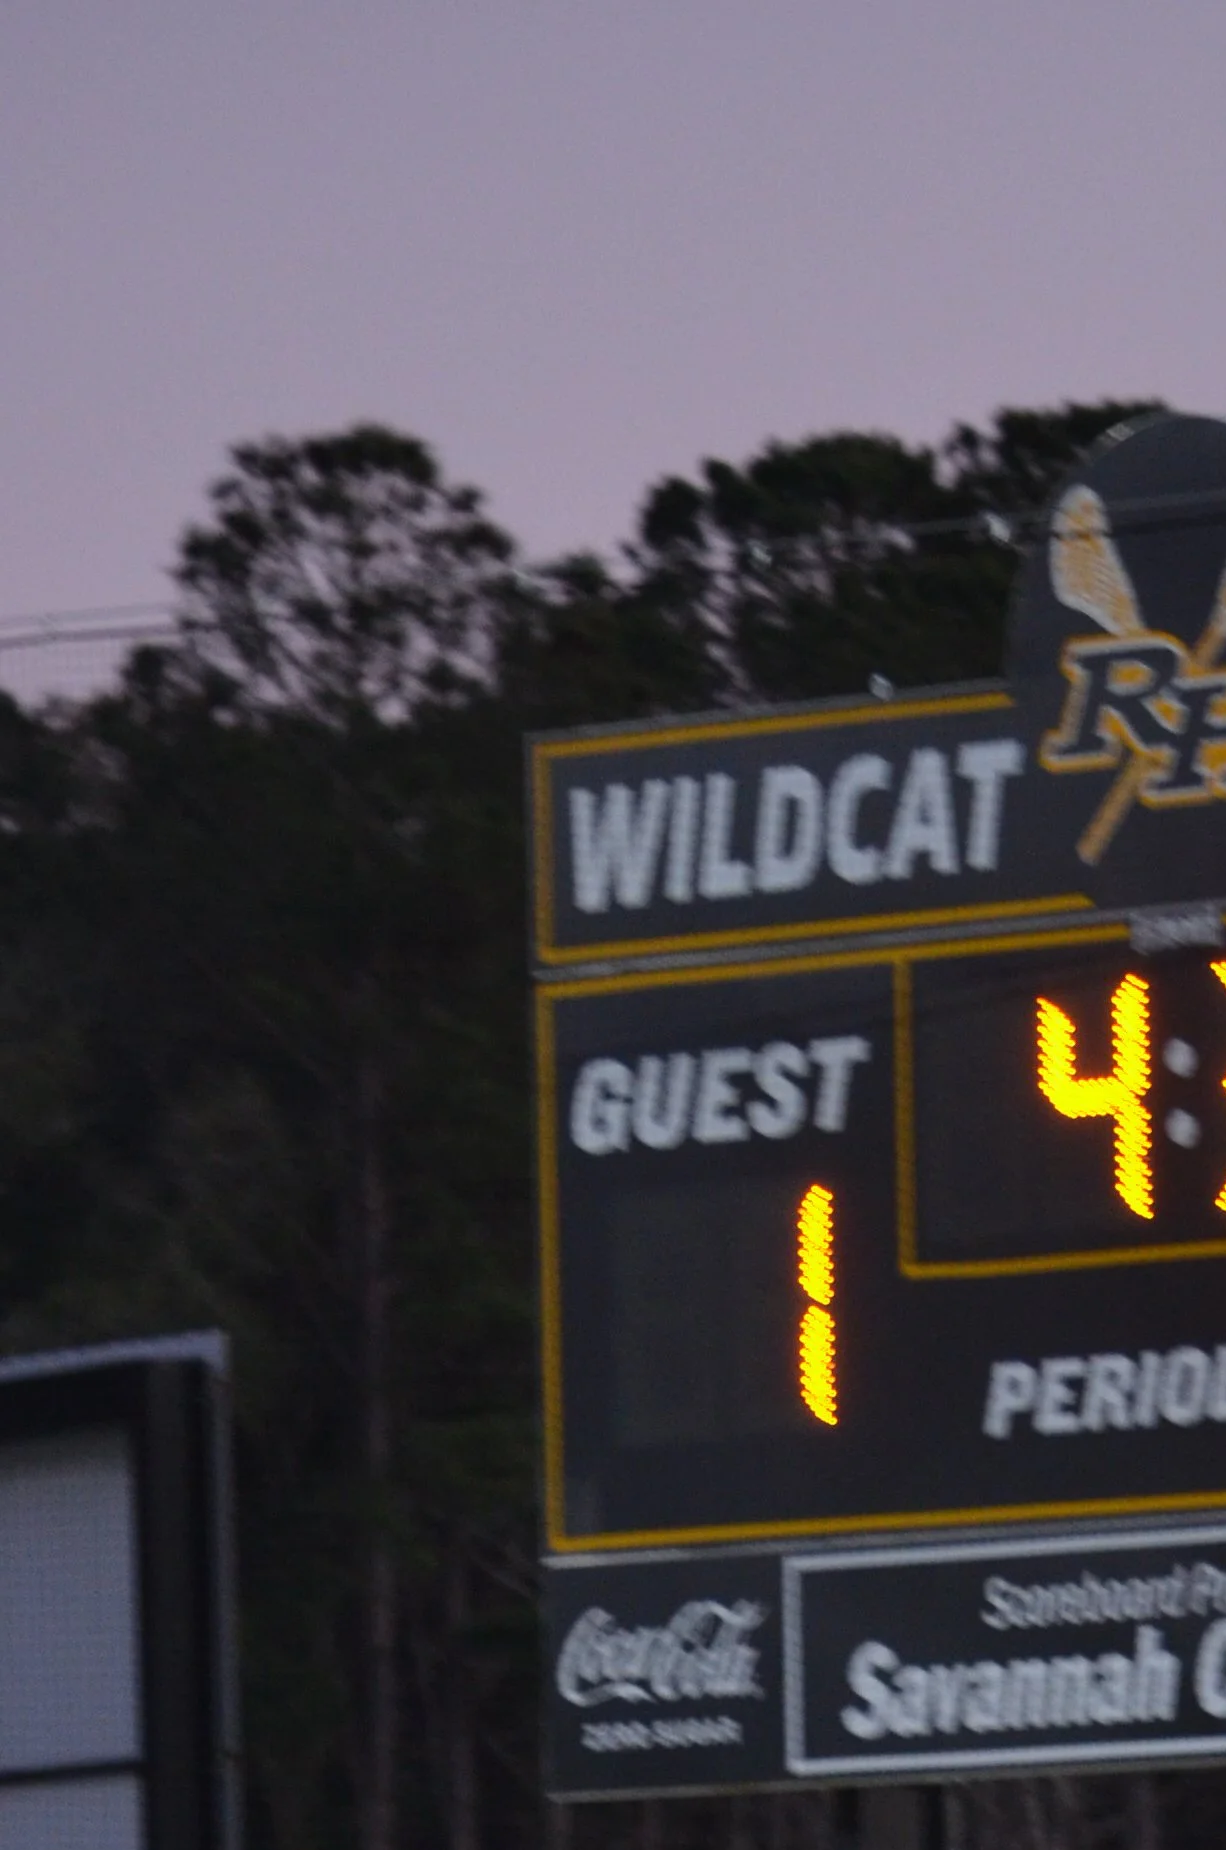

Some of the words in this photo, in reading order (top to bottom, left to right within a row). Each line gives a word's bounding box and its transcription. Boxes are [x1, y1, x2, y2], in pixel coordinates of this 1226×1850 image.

[568, 738, 1024, 915] WILDCAT
[570, 1035, 872, 1156] GUEST
[796, 1183, 838, 1426] 1
[840, 1624, 1181, 1741] Savannah
